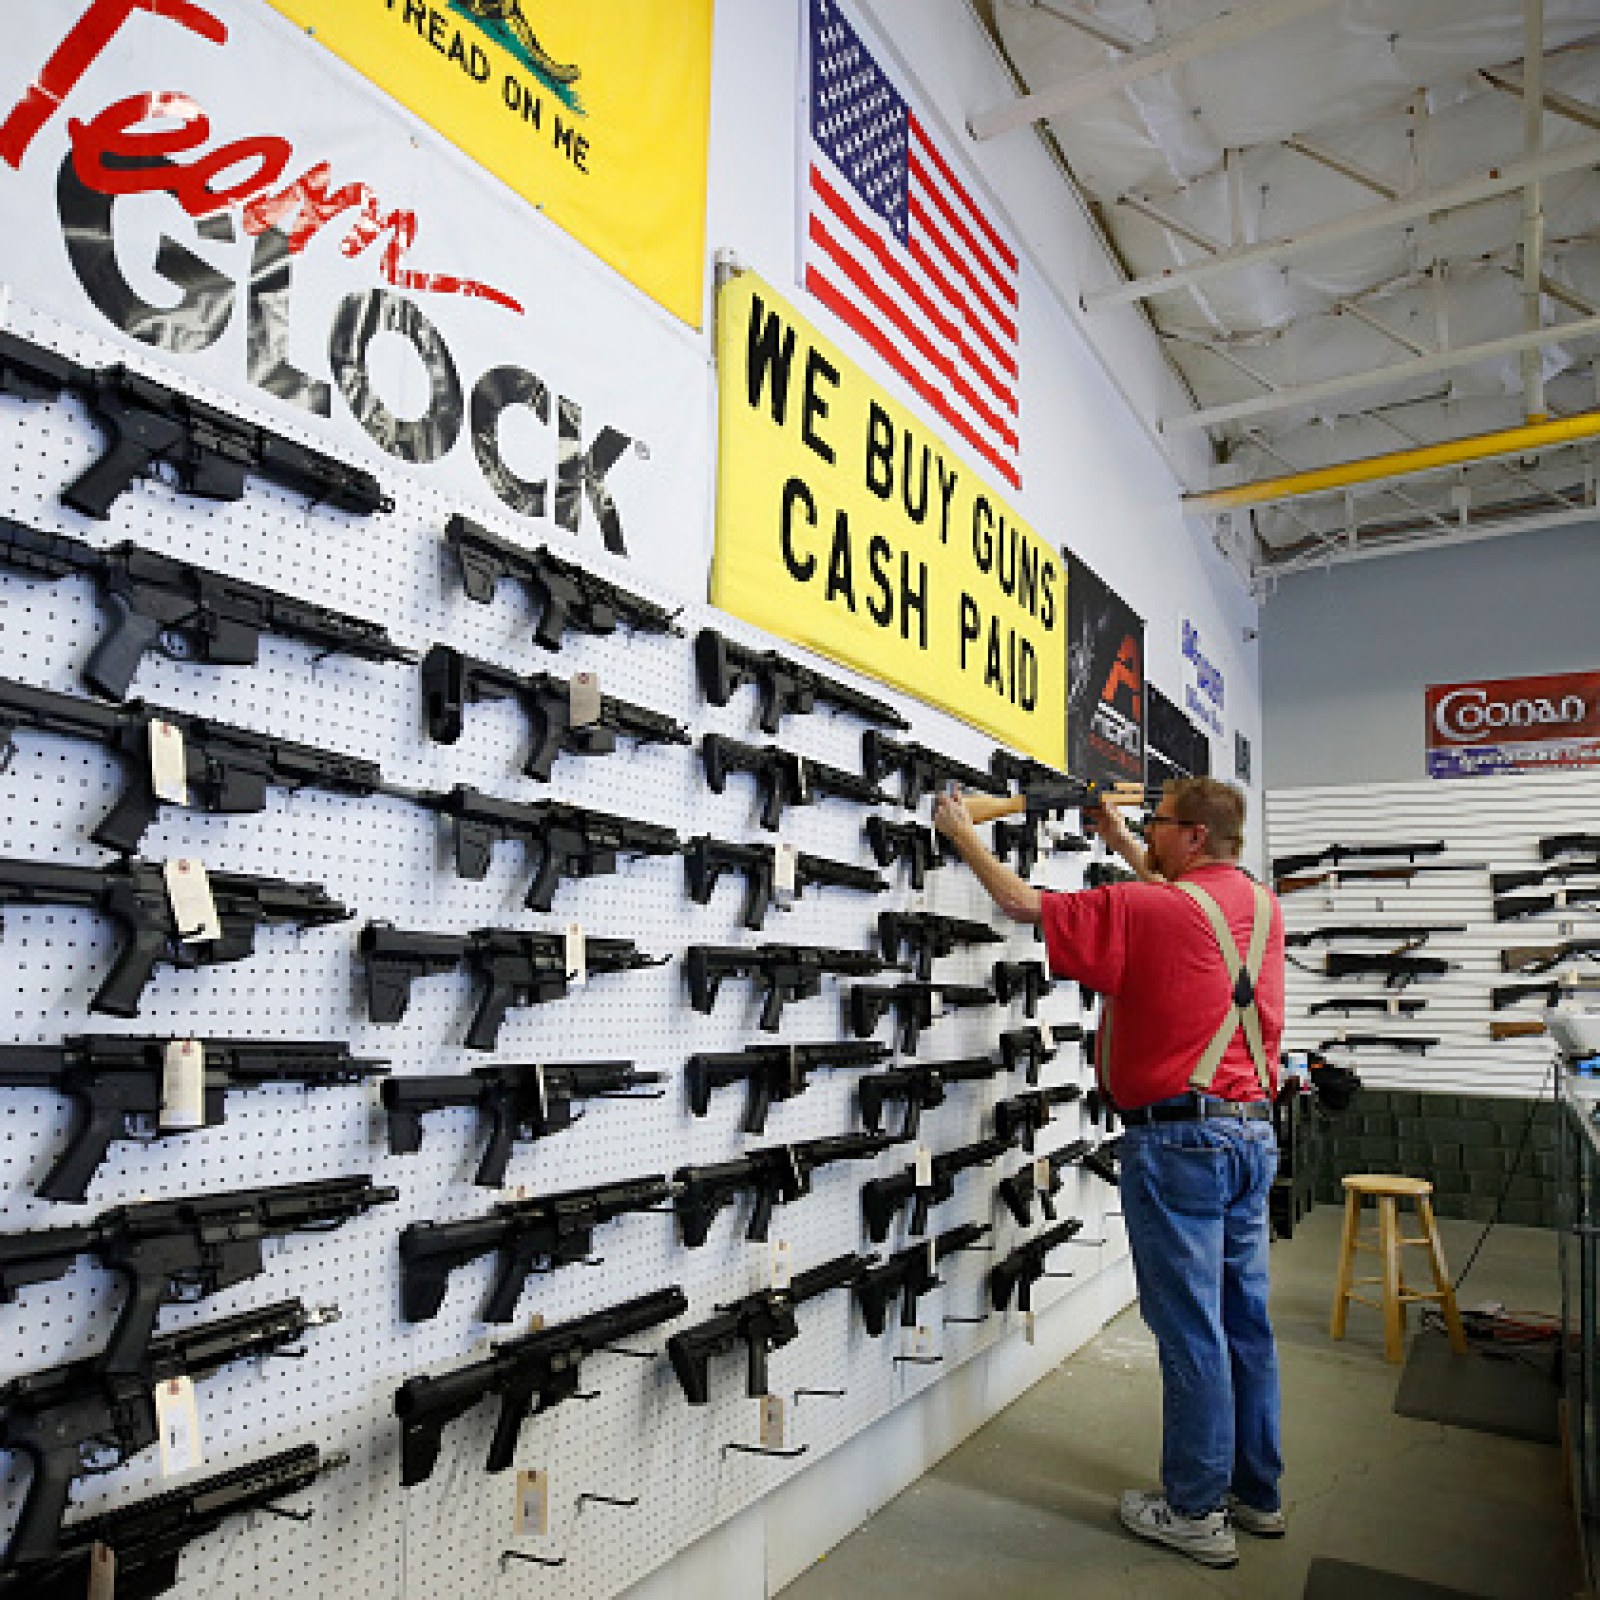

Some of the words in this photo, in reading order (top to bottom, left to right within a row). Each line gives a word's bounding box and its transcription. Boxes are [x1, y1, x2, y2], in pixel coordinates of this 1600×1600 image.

[385, 0, 491, 83] READ
[502, 75, 543, 132] ON
[551, 113, 590, 175] ME
[57, 148, 634, 558] GLOCK
[746, 292, 841, 466] WE
[865, 398, 959, 545] BUY
[972, 493, 1057, 632] GUNS
[779, 475, 930, 651] CASH
[958, 588, 1039, 715] PAID
[1434, 687, 1587, 742] Coonan
